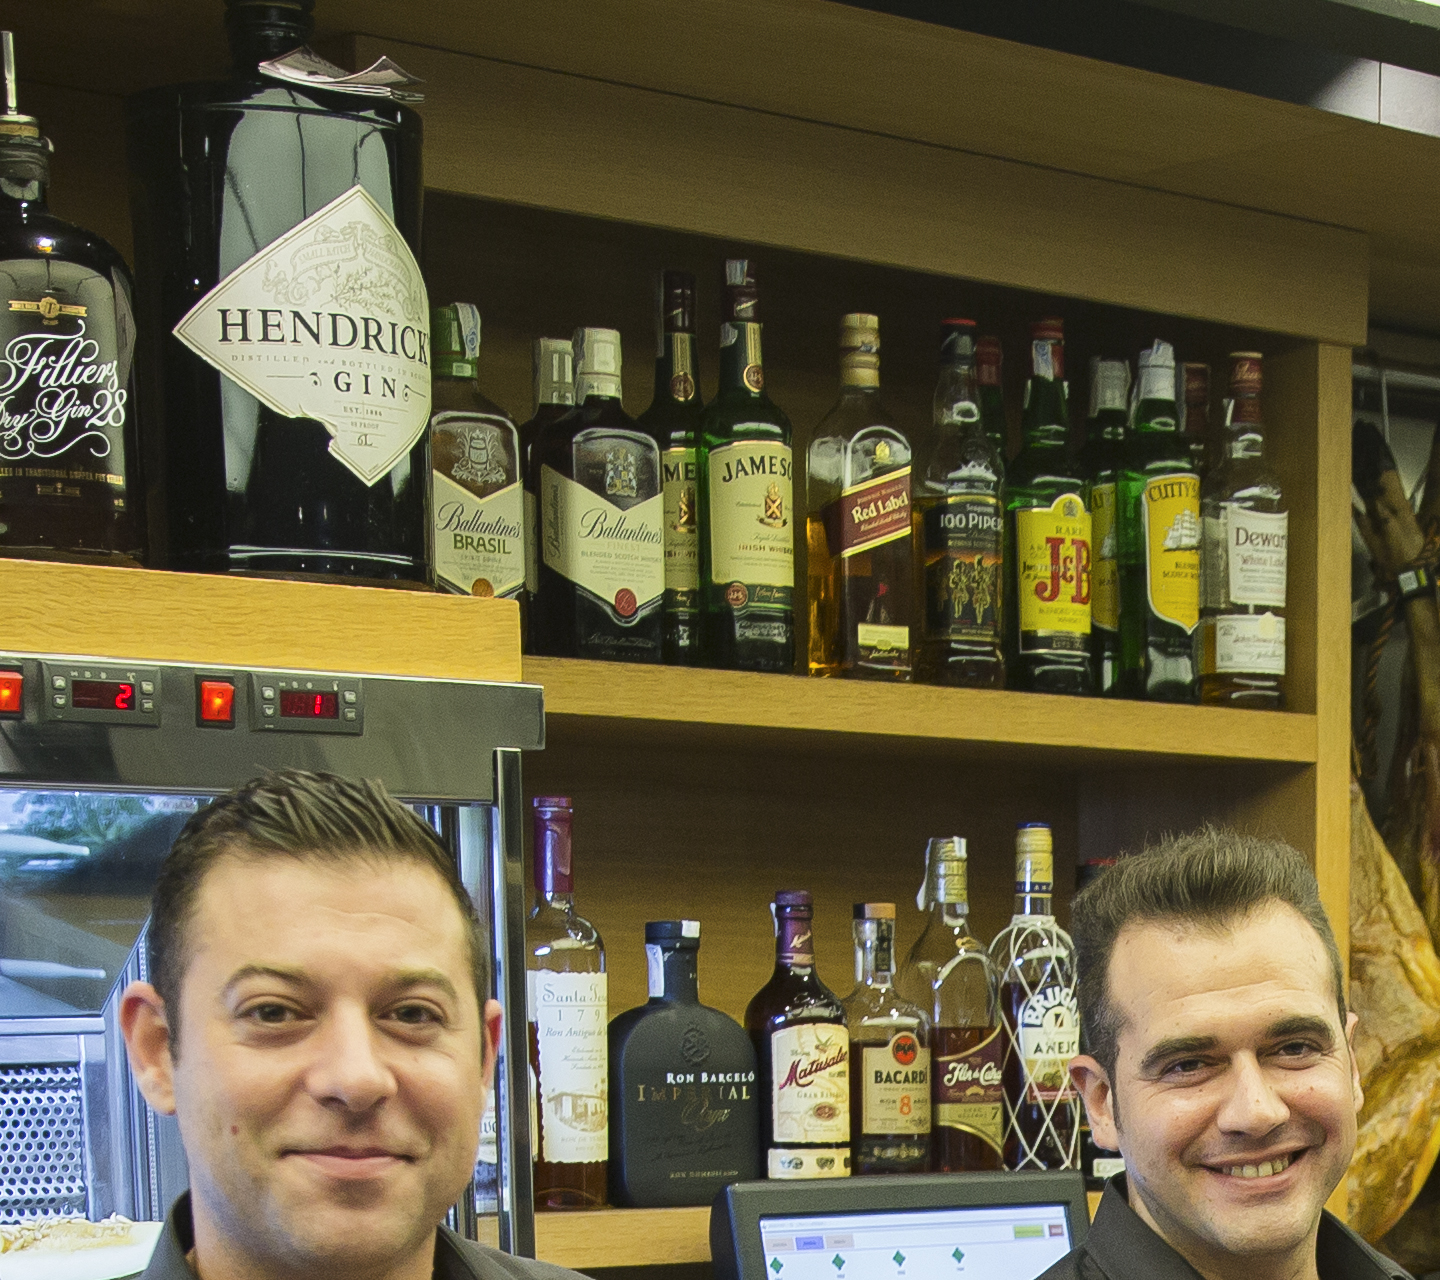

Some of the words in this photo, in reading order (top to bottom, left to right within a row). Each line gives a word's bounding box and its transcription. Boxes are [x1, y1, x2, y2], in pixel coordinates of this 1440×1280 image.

[231, 354, 309, 366] DISTILLED
[334, 371, 396, 399] GIN
[36, 387, 94, 442] Gin
[85, 389, 128, 428] 28
[357, 434, 373, 447] 6L
[851, 505, 877, 524] Red
[878, 491, 909, 515] Label
[436, 501, 521, 538] Ballantine's
[578, 508, 662, 544] Ballantine's
[941, 514, 966, 529] 100
[453, 533, 512, 555] BRASIL
[115, 684, 132, 709] 2
[315, 695, 322, 715] 1
[542, 983, 587, 1002] Santa
[545, 1027, 564, 1036] Ron
[943, 1062, 972, 1087] Flor
[638, 1085, 750, 1101] IMPERIAL
[899, 1095, 912, 1115] 8
[992, 1106, 1000, 1121] 7
